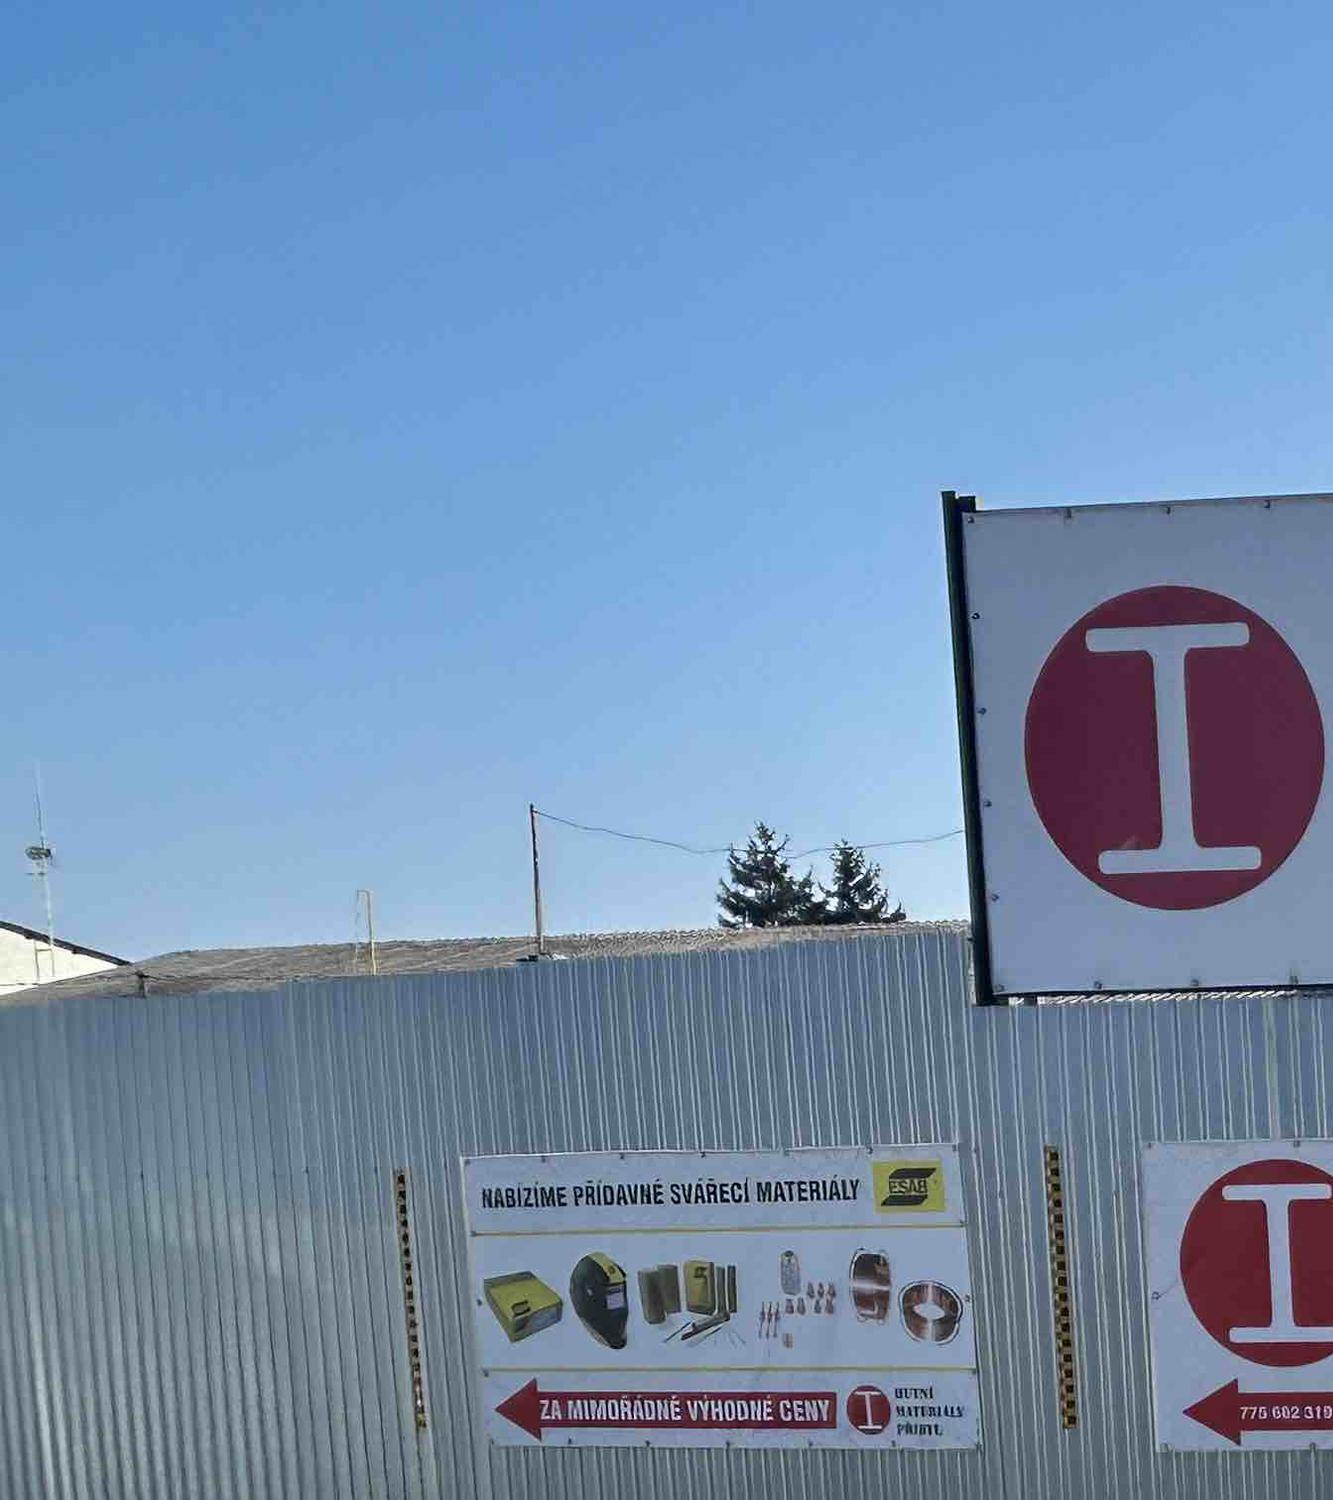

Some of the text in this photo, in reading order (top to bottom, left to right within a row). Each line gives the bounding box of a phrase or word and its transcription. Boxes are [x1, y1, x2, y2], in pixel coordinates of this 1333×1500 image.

[482, 1174, 860, 1208] NABÍZÍME PŘÍDAVNÉ SVÁŘECÍ MATERIÁLY
[540, 1394, 830, 1421] ZA MIMOŘÁDNÉ VÝHODNÉ CENY
